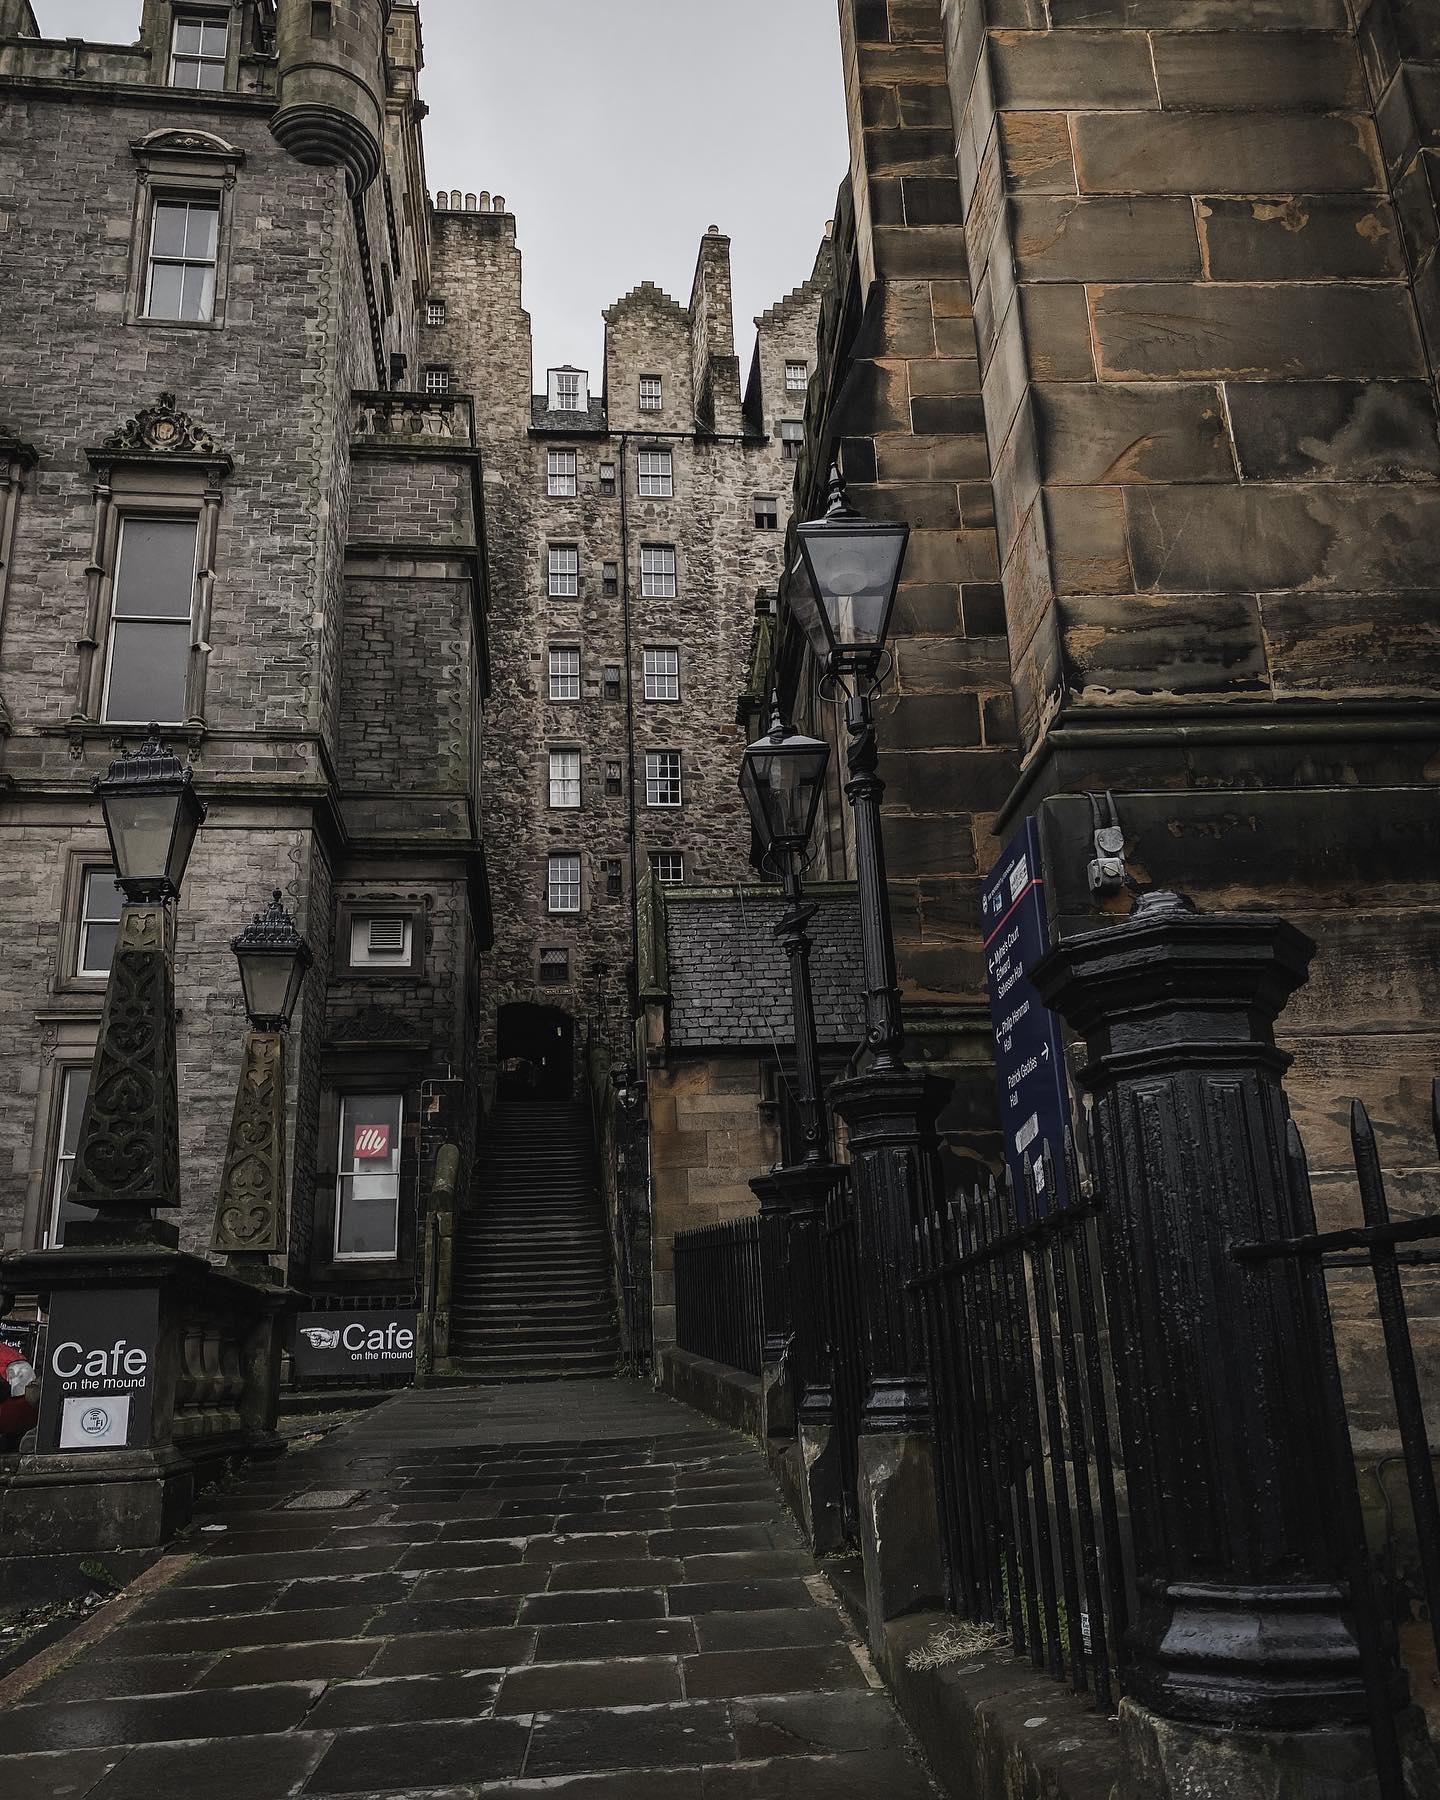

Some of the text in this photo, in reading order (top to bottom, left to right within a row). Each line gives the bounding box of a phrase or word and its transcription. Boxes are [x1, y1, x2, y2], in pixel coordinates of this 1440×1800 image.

[1008, 926, 1019, 947] Court
[996, 956, 1011, 981] Edward
[998, 962, 1023, 999] Salvesen Hall
[1002, 1015, 1013, 1035] Philip
[1004, 1035, 1012, 1053] Hall
[1007, 1056, 1037, 1089] Patrick Geddes
[1010, 1091, 1018, 1108] Hall
[355, 1129, 386, 1155] illy
[343, 1322, 414, 1351] Cafe
[52, 1340, 147, 1377] Cafe
[365, 1351, 379, 1360] the
[381, 1350, 414, 1359] mound
[62, 1376, 147, 1390] on the mound
